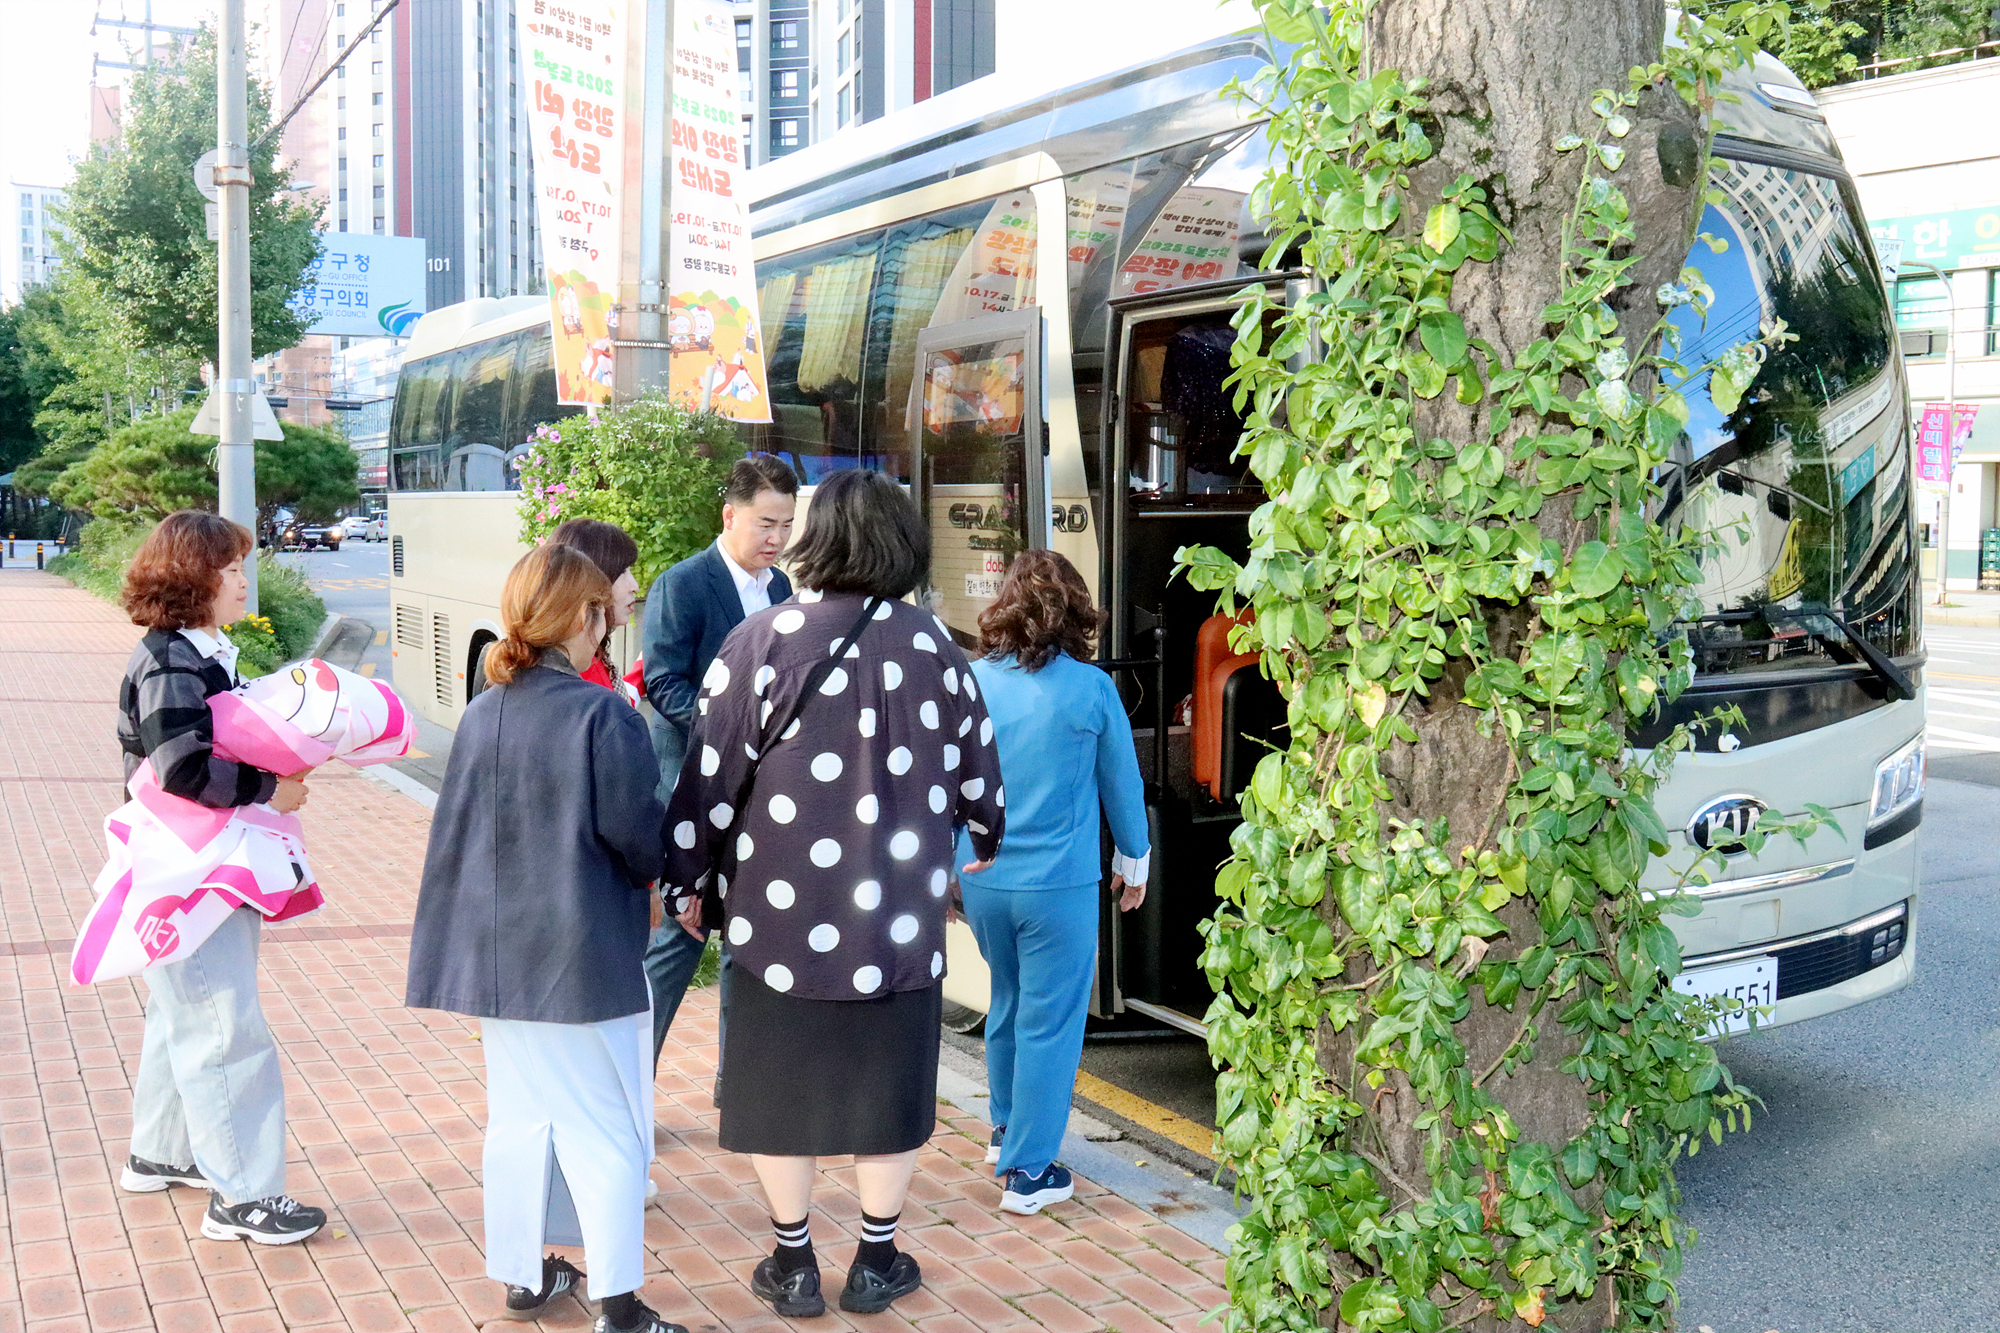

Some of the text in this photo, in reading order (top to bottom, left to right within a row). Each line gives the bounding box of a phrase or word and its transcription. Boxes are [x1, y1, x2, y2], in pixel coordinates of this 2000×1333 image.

[1162, 212, 1180, 222] 책이
[1196, 217, 1225, 227] 상상이
[1174, 224, 1201, 235] 팝업북
[1068, 246, 1096, 264] 외
[1139, 240, 1184, 253] 2025
[311, 252, 370, 274] 봉구청
[427, 257, 450, 272] 101
[1120, 255, 1180, 277] 광장
[341, 273, 368, 282] OFFICE
[335, 310, 367, 318] COUNCIL
[1922, 413, 1944, 480] 신데렐라
[948, 502, 1089, 533] GRARD
[1706, 807, 1761, 847] KIA
[1723, 980, 1771, 1021] 1551
[245, 1208, 269, 1226] N
